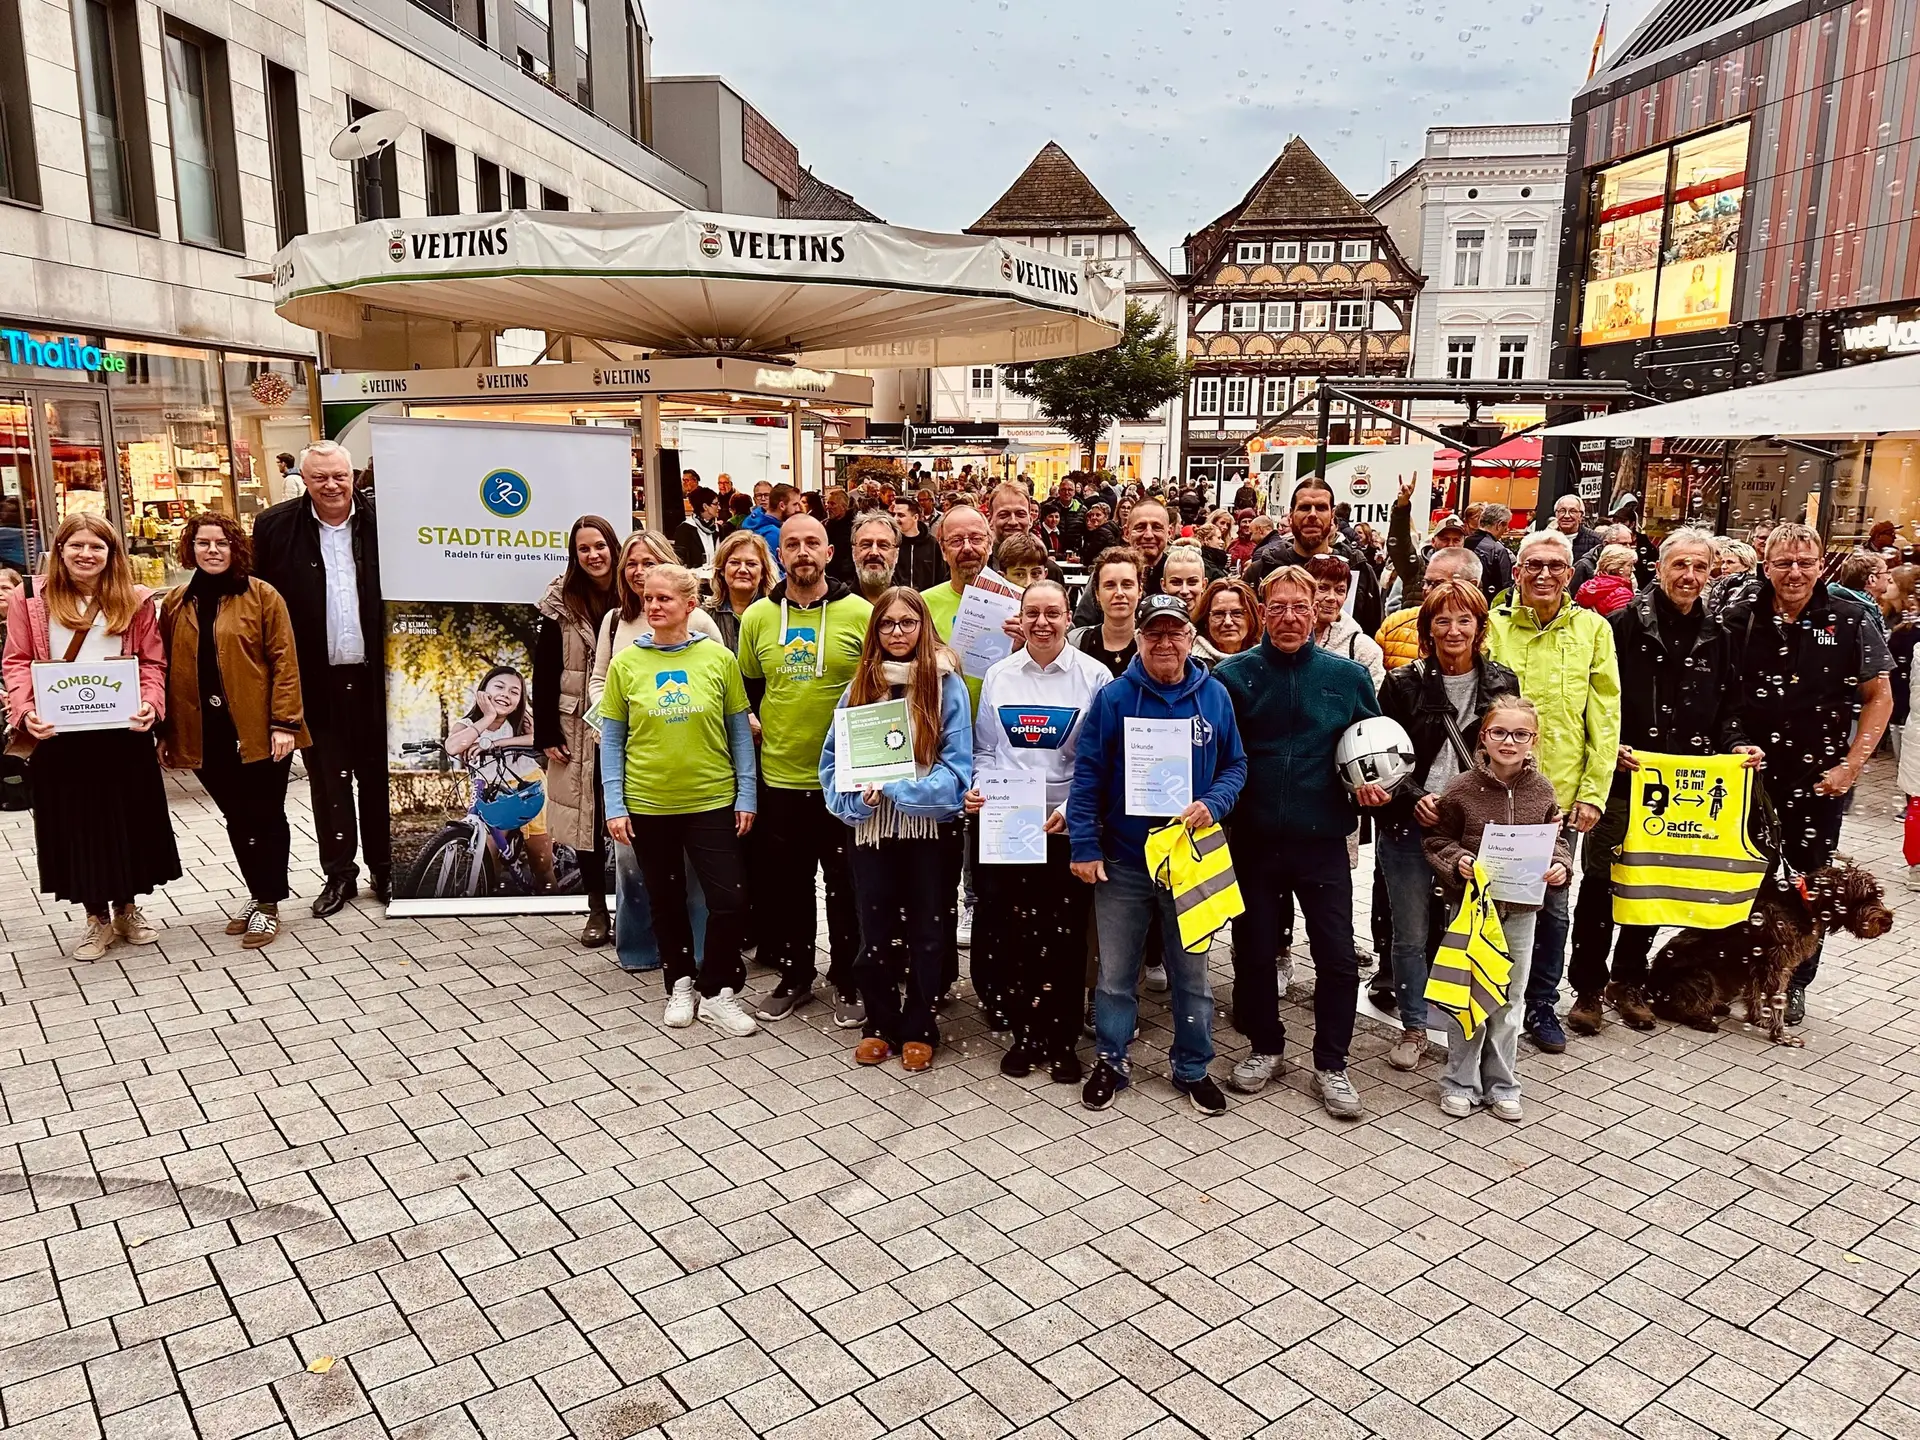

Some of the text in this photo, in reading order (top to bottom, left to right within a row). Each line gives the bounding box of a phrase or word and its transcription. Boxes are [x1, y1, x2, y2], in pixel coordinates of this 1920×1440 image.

[411, 228, 508, 259] VELTINS
[727, 231, 845, 263] VELTINS
[1015, 258, 1078, 296] VELTINS
[486, 373, 529, 388] VELTINS
[603, 369, 651, 385] VELTINS
[369, 378, 407, 393] VELTINS
[912, 425, 954, 434] avana Club
[1007, 428, 1045, 436] buonissimo
[1350, 503, 1389, 522] TIN
[444, 550, 569, 562] Radeln für ein gutes Klima
[775, 664, 828, 674] FÜRSTENU
[47, 675, 123, 694] TOMBOLA
[60, 702, 116, 712] STADTRADELN
[1010, 725, 1057, 735] optibelt
[1130, 743, 1154, 751] Urkunde
[1675, 769, 1689, 778] GIB
[1691, 780, 1705, 791] m!
[1666, 820, 1703, 833] adfc
